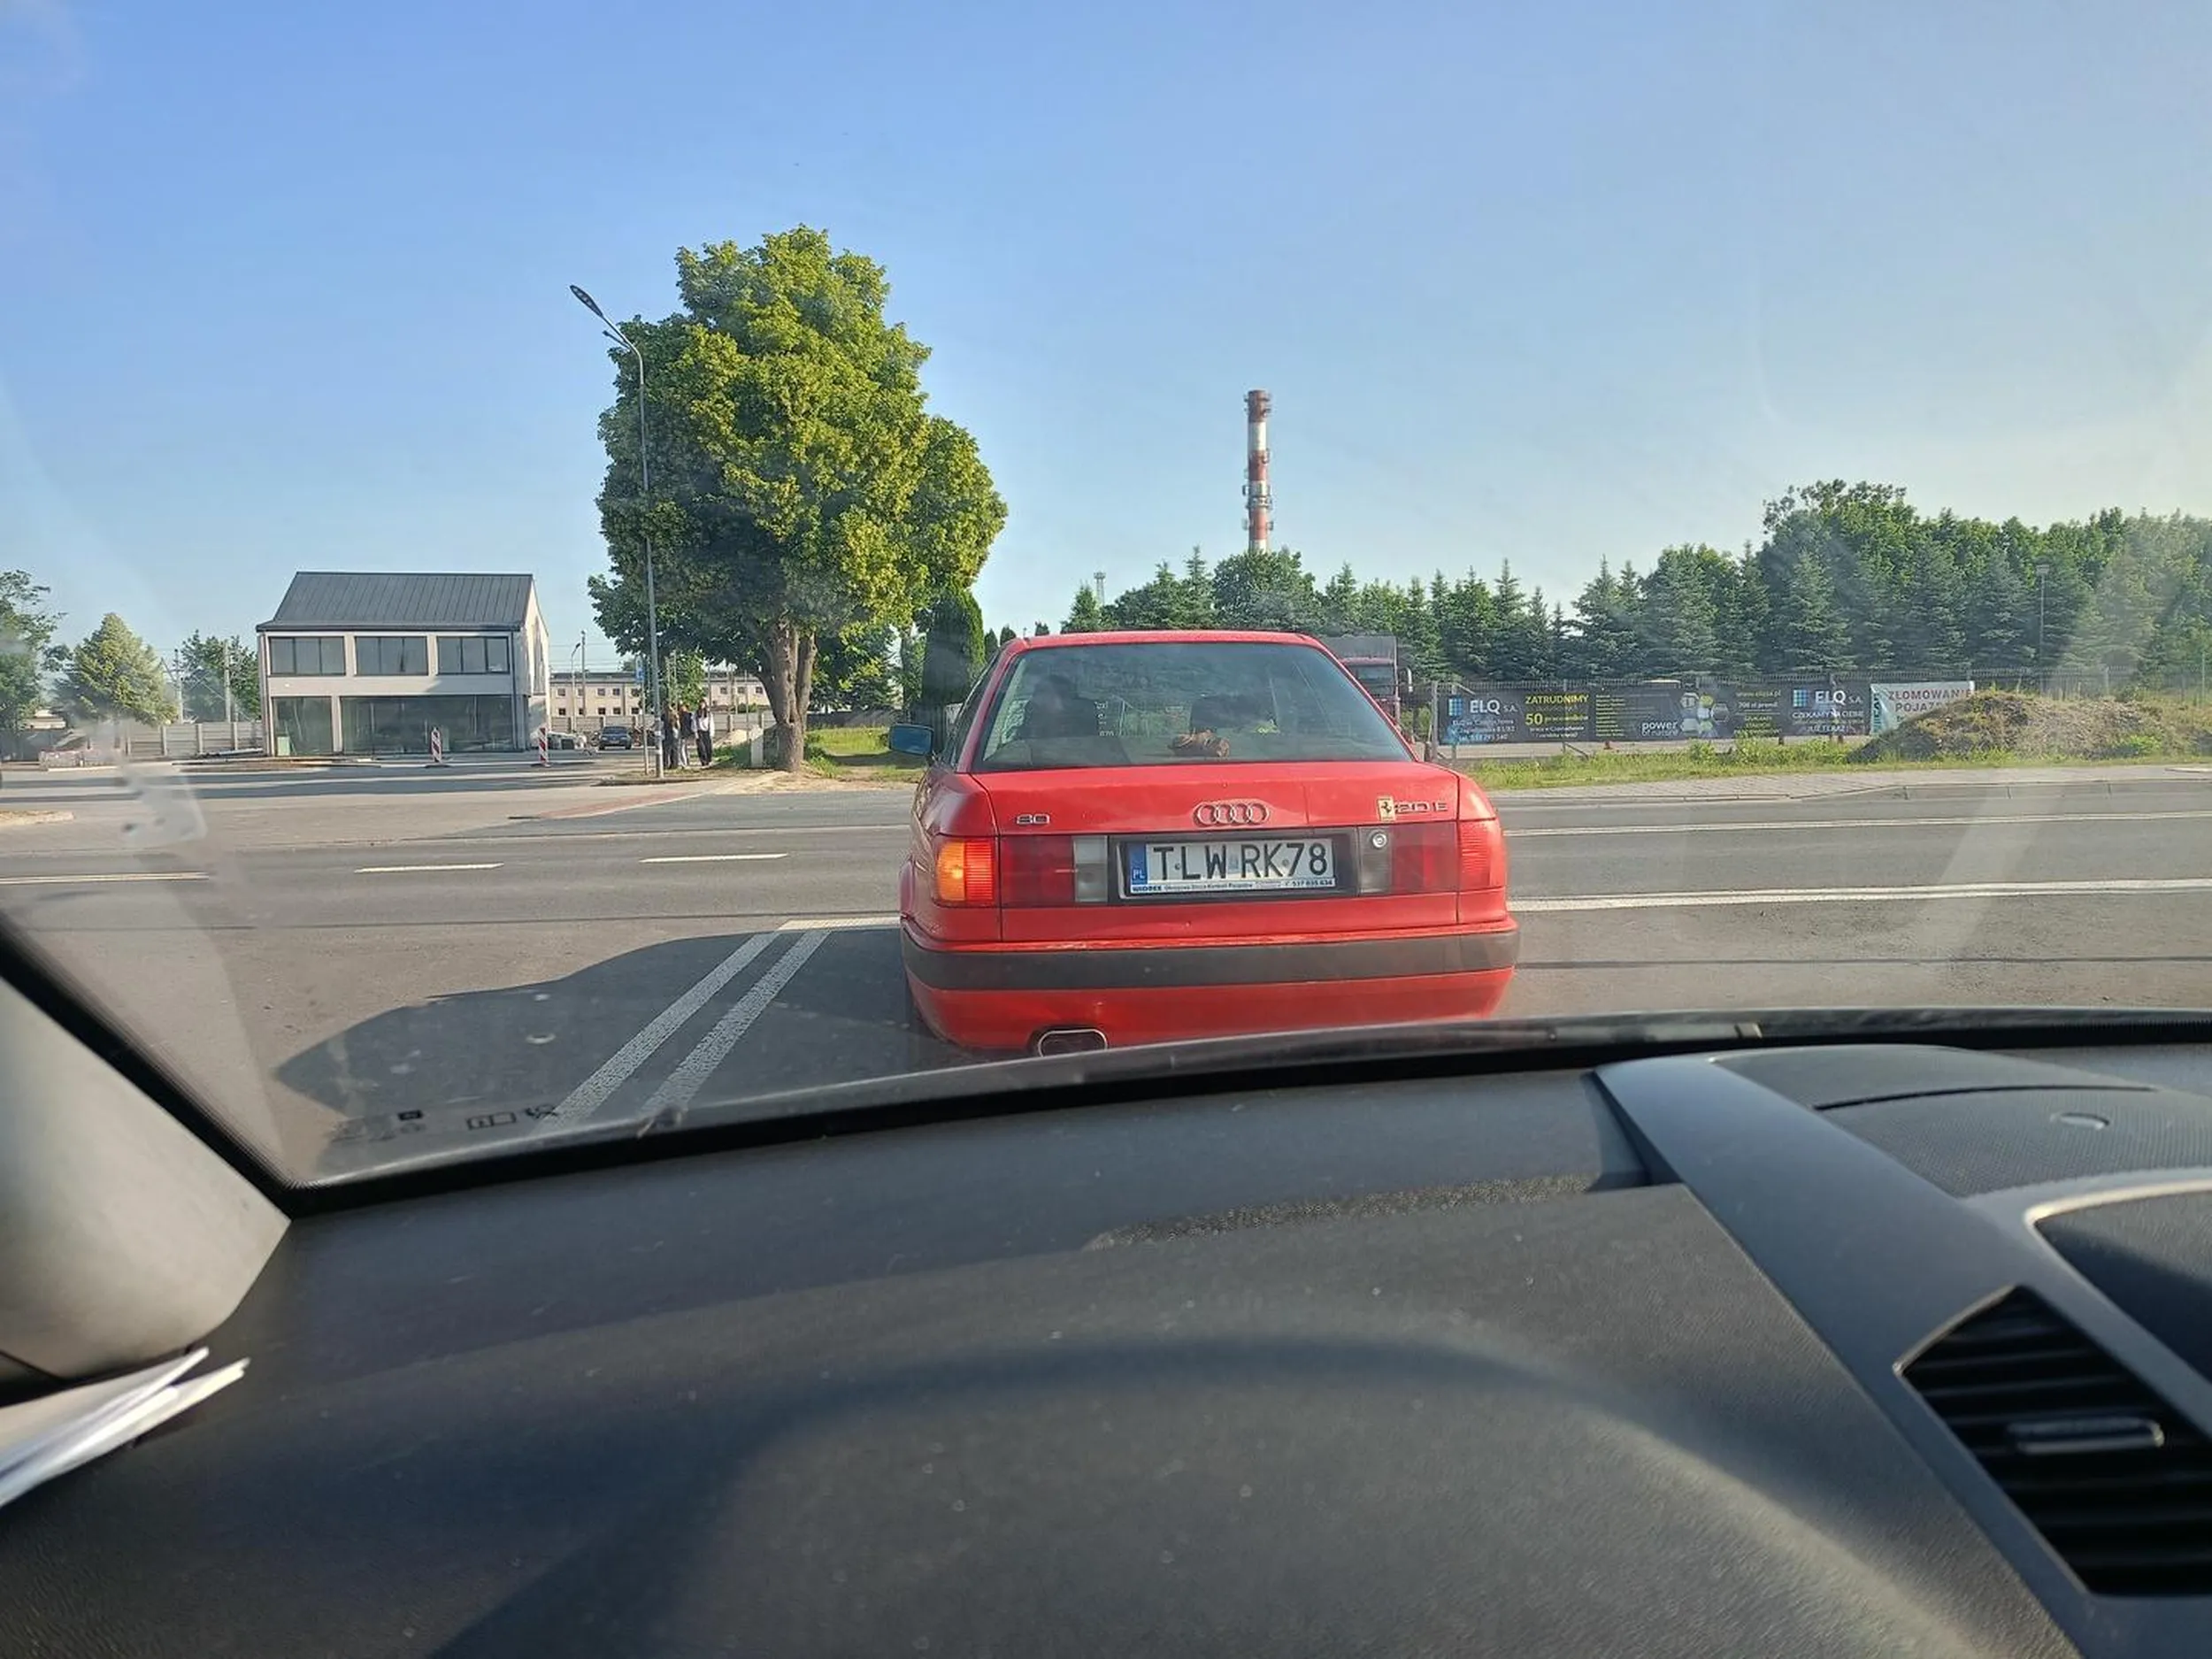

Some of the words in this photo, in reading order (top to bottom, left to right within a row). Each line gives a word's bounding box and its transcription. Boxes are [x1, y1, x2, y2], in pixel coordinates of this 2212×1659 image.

[1525, 695, 1589, 705] ZATRUDNIMY
[1815, 690, 1846, 705] ELQ
[1470, 699, 1501, 715] ELQ
[1525, 712, 1544, 726] 50
[1641, 721, 1678, 731] power
[1017, 813, 1050, 825] 80
[1153, 845, 1226, 880] TLW
[1240, 842, 1327, 878] RK78
[1133, 868, 1146, 879] PL
